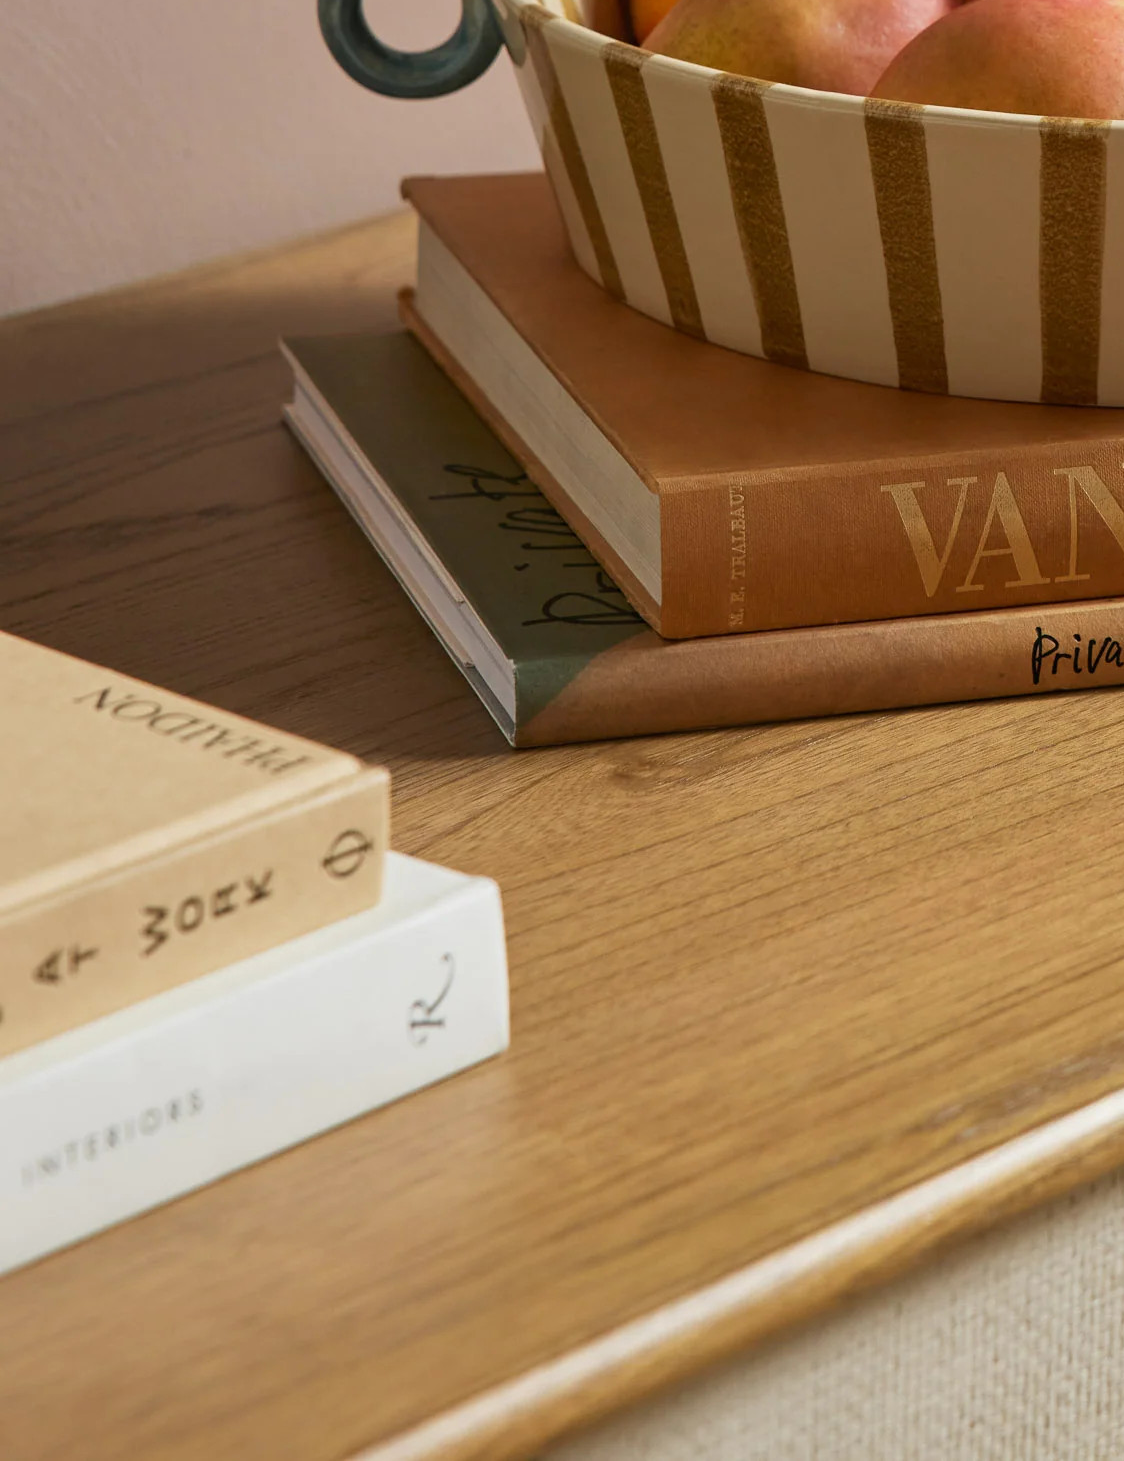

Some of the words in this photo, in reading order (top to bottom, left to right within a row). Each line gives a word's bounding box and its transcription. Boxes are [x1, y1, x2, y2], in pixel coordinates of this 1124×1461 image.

[73, 686, 314, 776] PHAIDON
[32, 941, 100, 986] AT
[138, 866, 274, 957] WORK
[20, 1087, 204, 1188] INTERIORS
